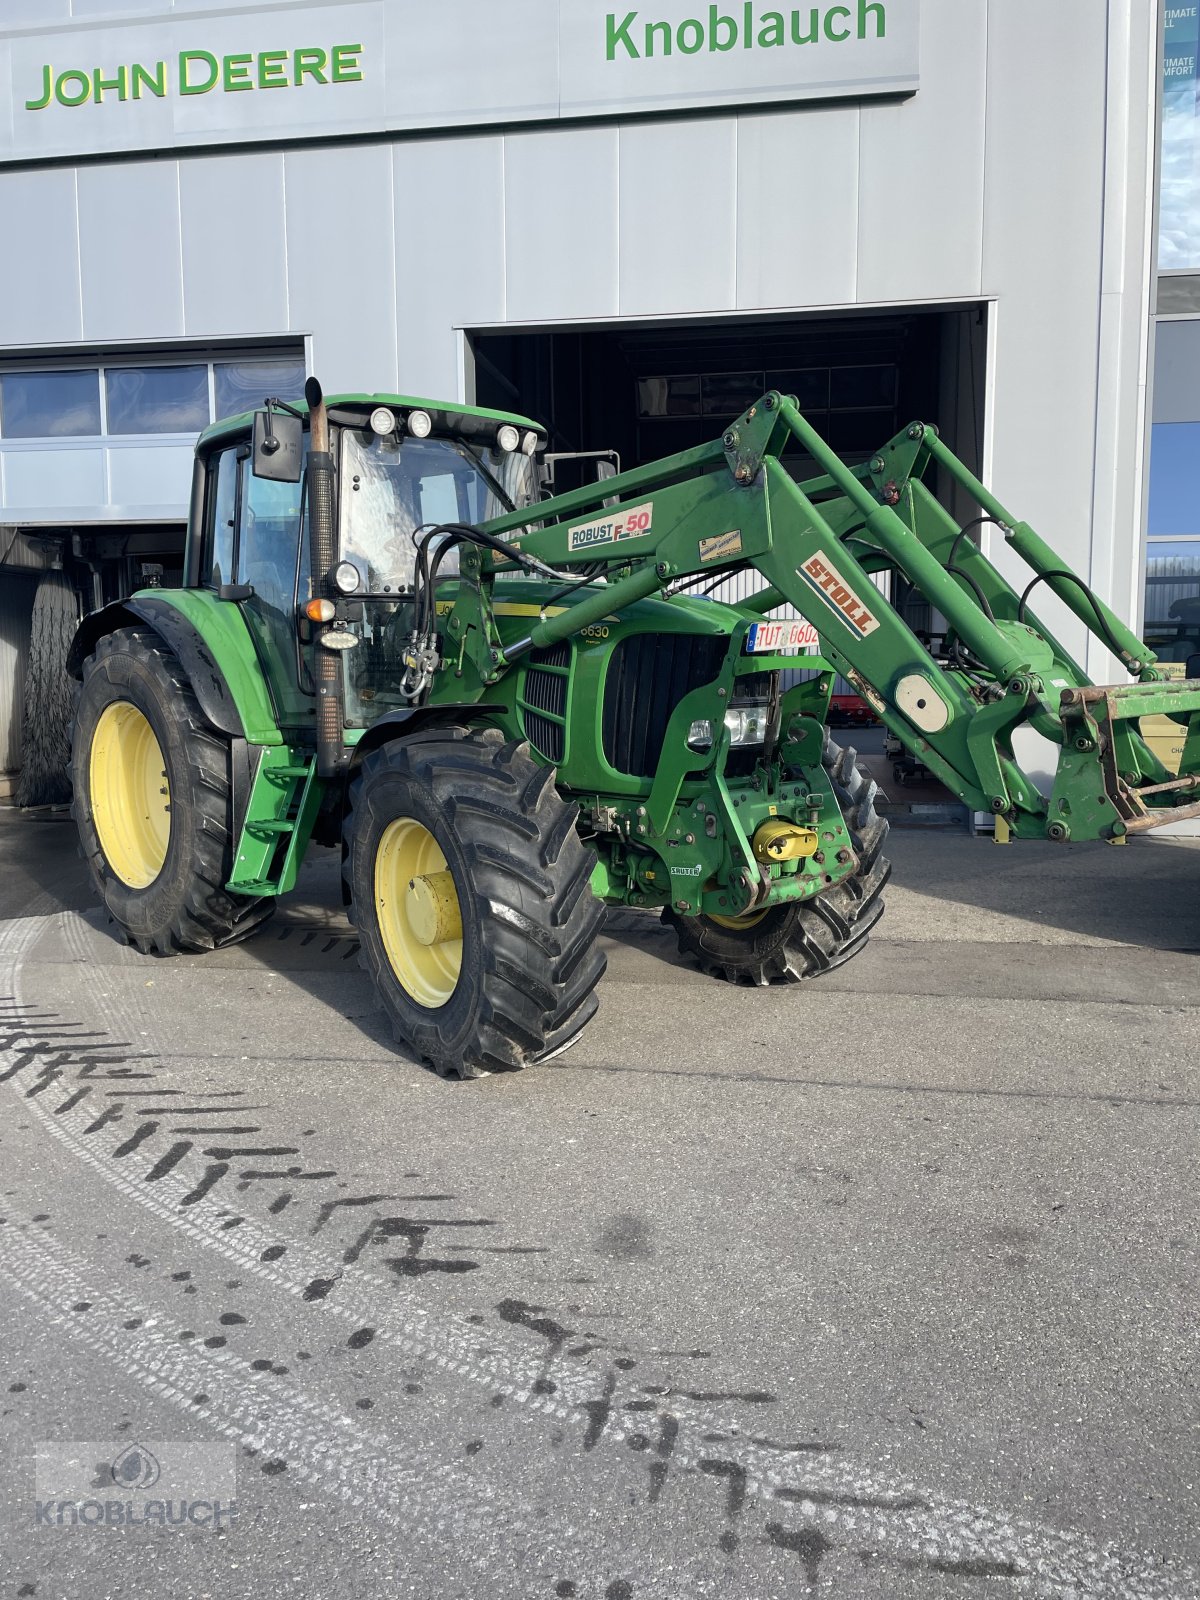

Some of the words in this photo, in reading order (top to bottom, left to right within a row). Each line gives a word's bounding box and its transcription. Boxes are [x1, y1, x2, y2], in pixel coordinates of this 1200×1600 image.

[606, 0, 886, 61] Knoblauch
[25, 61, 165, 110] JOHN
[179, 43, 363, 96] DEERE
[572, 523, 613, 545] ROBUST
[626, 511, 650, 532] 50
[804, 557, 873, 633] STOLL
